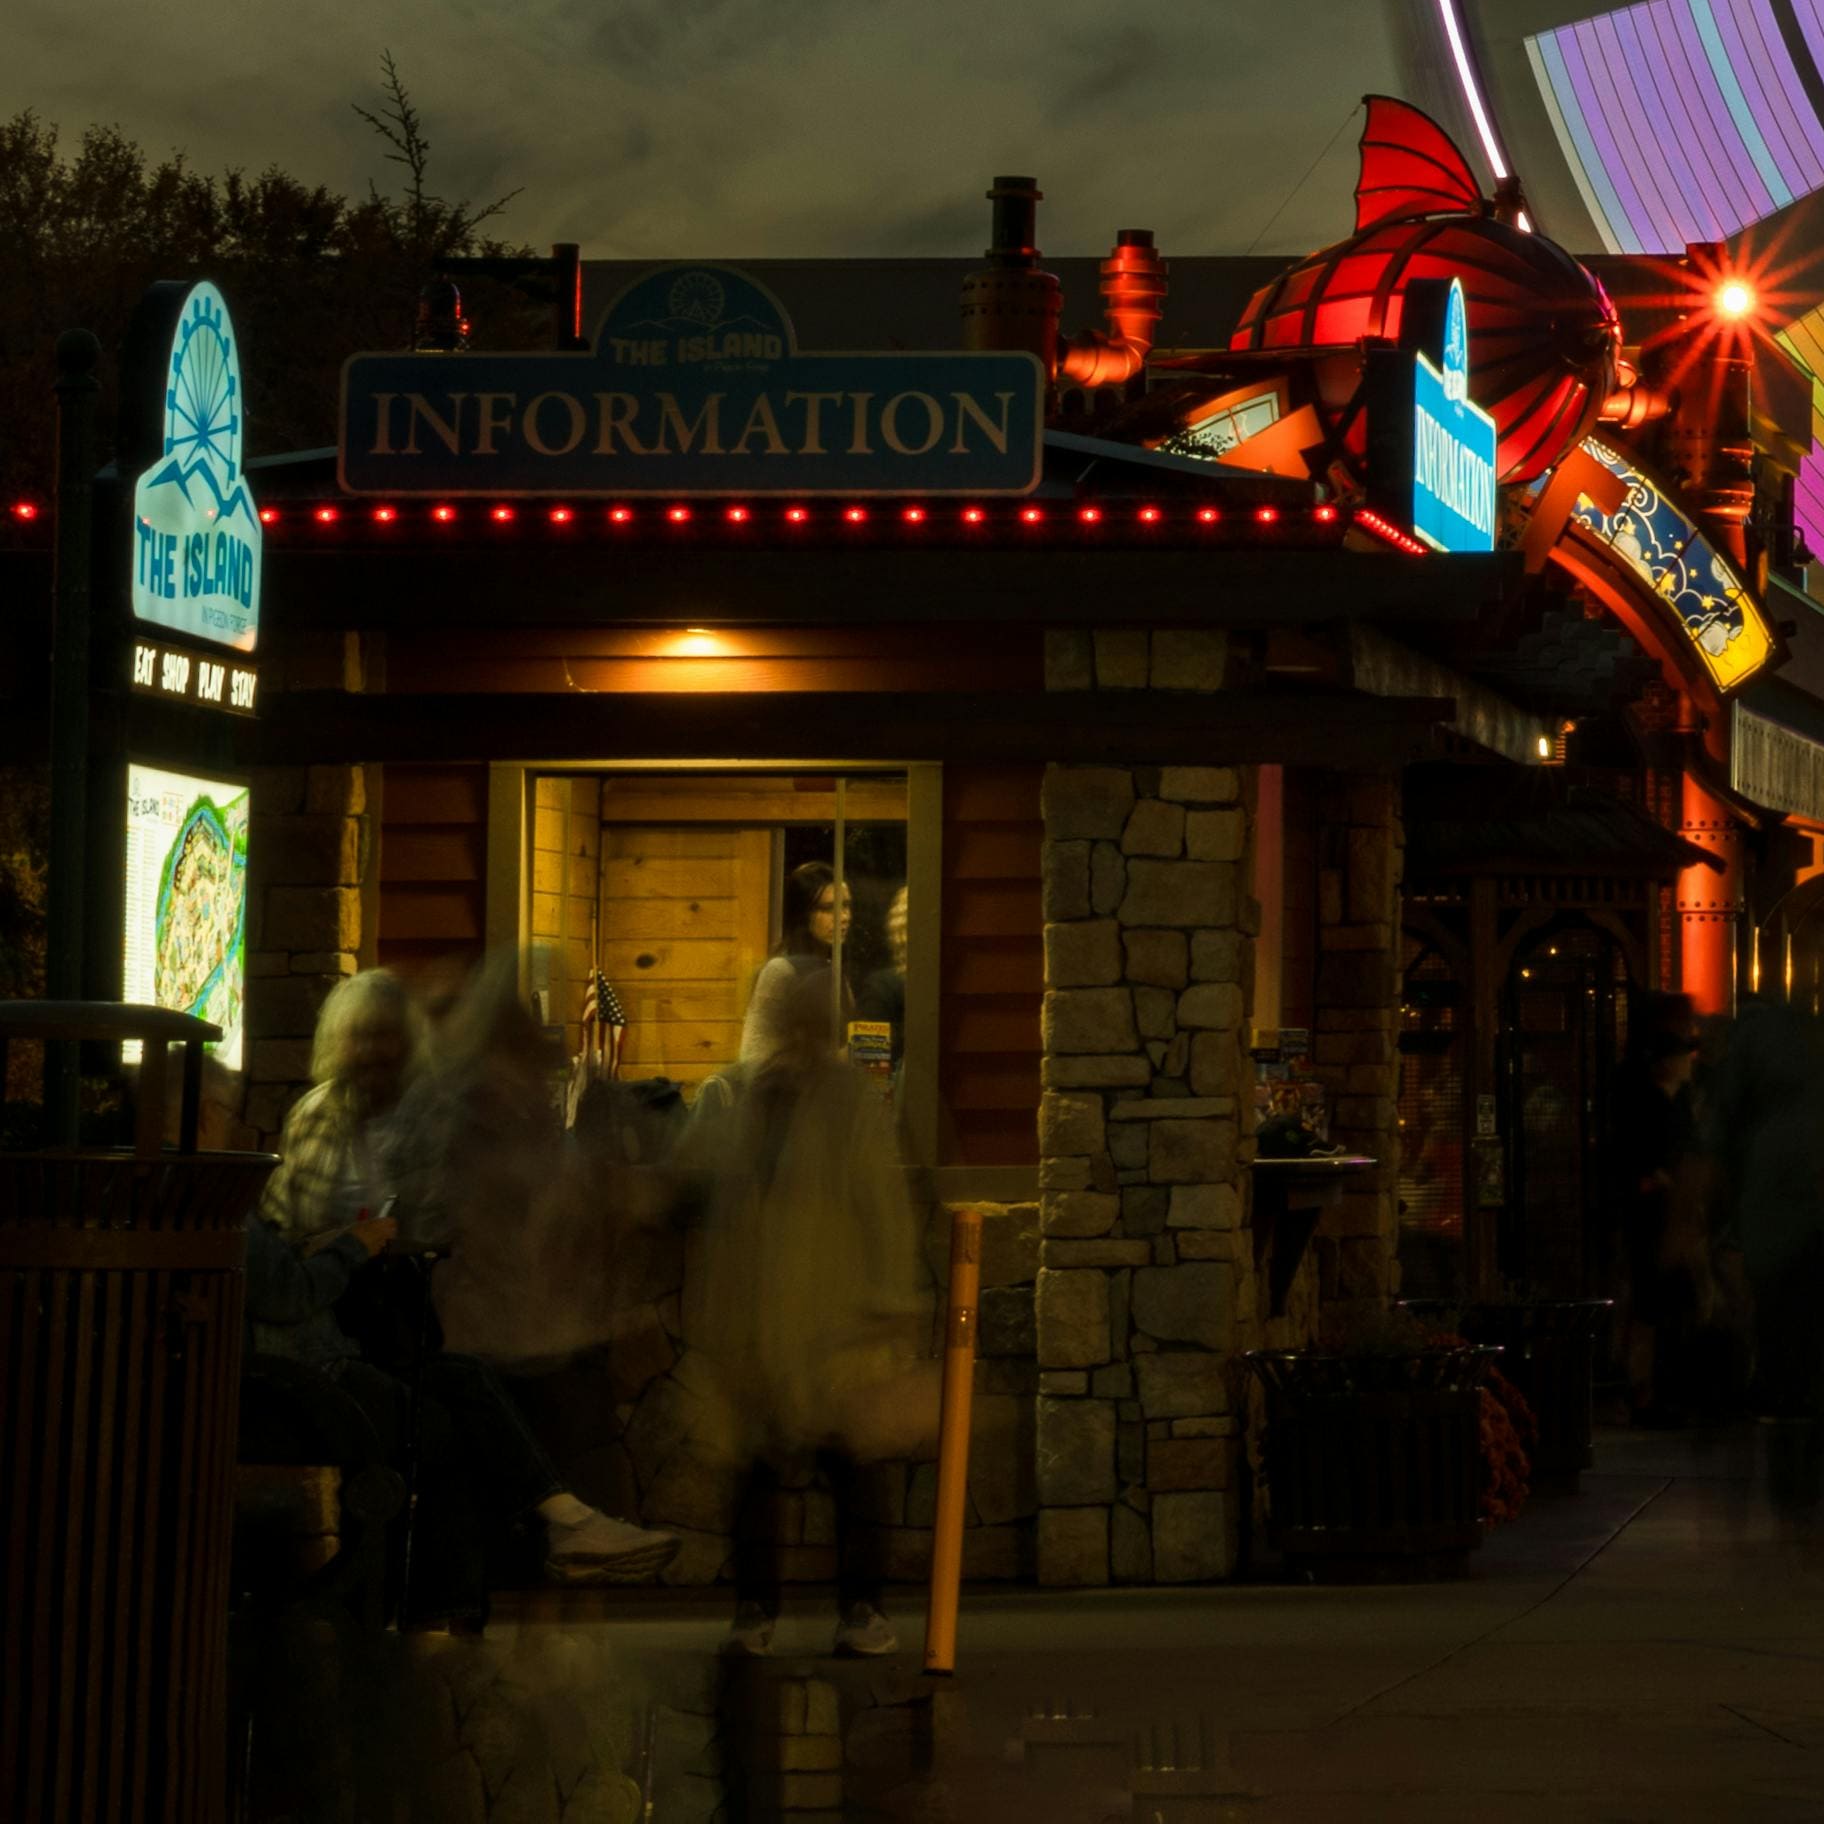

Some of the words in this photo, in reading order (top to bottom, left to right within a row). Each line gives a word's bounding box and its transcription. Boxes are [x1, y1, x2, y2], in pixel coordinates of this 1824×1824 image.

[608, 337, 670, 366] THE
[677, 332, 782, 364] ISLAND
[368, 390, 1016, 457] INFORMATION
[1416, 402, 1494, 537] INFORMATION
[136, 514, 177, 600] THE
[184, 530, 254, 610] ISLAND
[133, 645, 157, 687] EAT
[162, 651, 190, 695] SHOP
[198, 661, 225, 703] PLAY
[231, 669, 258, 709] STAY
